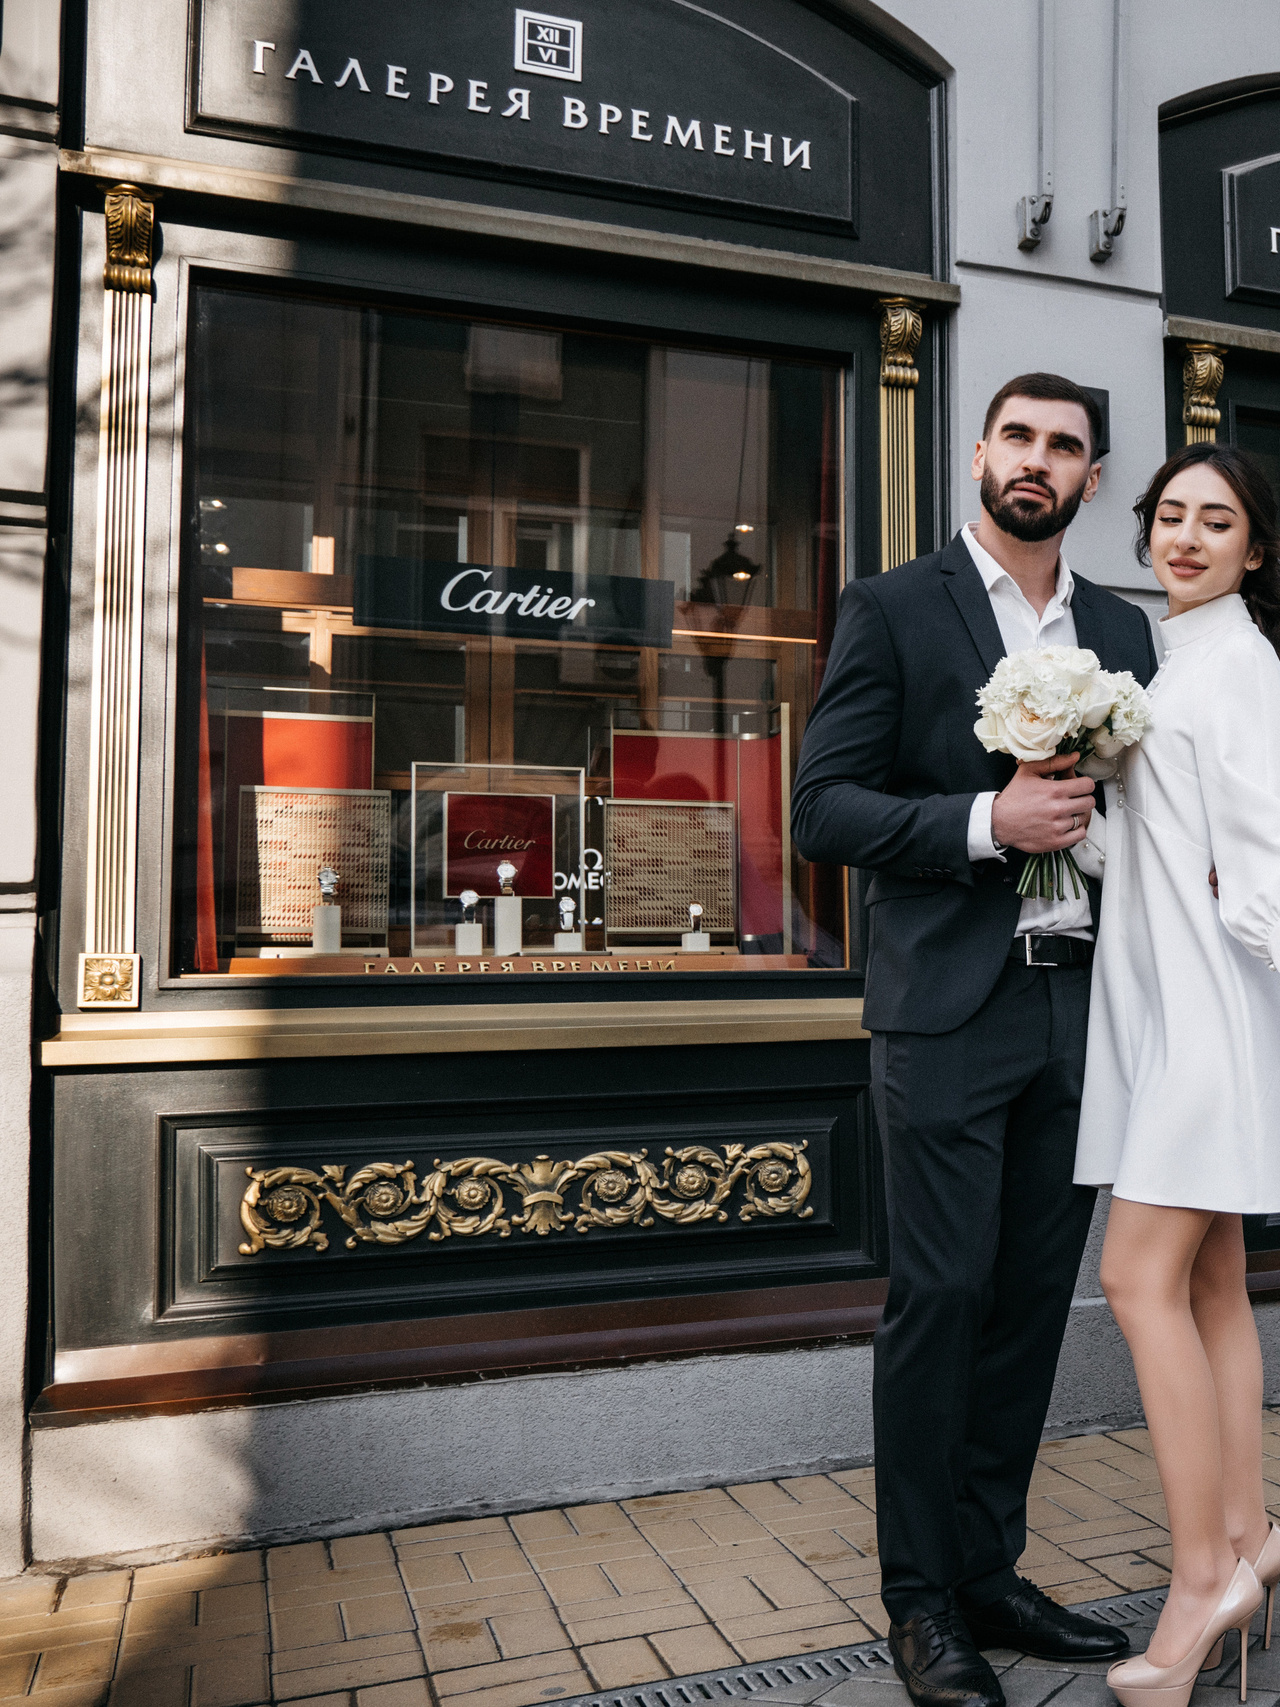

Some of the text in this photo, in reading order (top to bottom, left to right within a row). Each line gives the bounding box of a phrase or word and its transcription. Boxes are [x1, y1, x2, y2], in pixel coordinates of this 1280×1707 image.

[536, 25, 560, 44] XII
[537, 46, 557, 64] VI
[253, 40, 811, 169] ГАЛЕРЕЯ ВРЕМЕНИ
[440, 568, 596, 621] Cartier
[463, 829, 536, 850] Cartier
